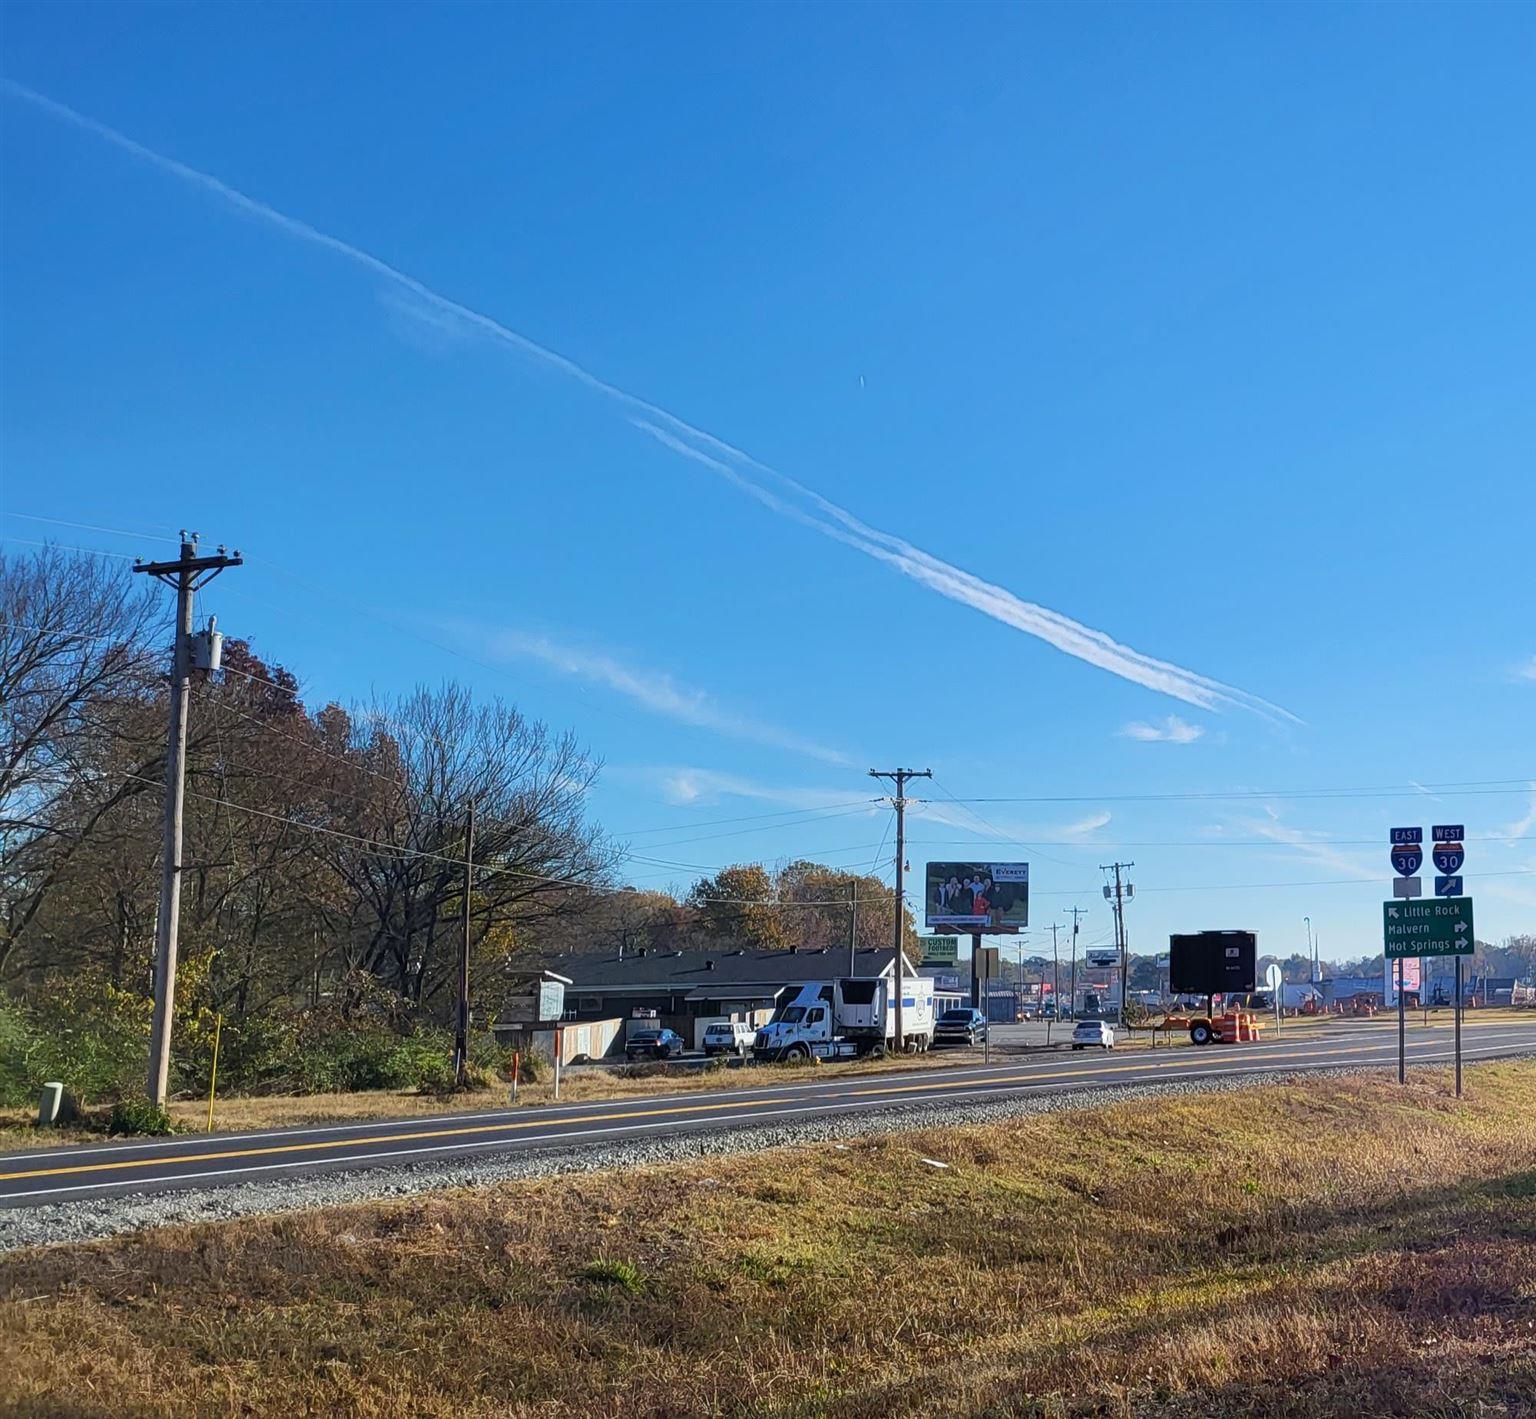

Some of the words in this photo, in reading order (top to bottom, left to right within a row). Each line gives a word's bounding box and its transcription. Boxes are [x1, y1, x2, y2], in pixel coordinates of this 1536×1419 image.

[1395, 831, 1417, 841] EAST
[1435, 829, 1461, 839] WEST
[1398, 858, 1417, 870] 30
[1439, 856, 1459, 868] 30
[1404, 907, 1431, 918] Little
[1435, 905, 1460, 915] Rock
[1388, 924, 1430, 935] Malvern
[928, 938, 957, 946] CUSTOM
[1389, 941, 1407, 952] Hot
[1411, 939, 1450, 953] Springs
